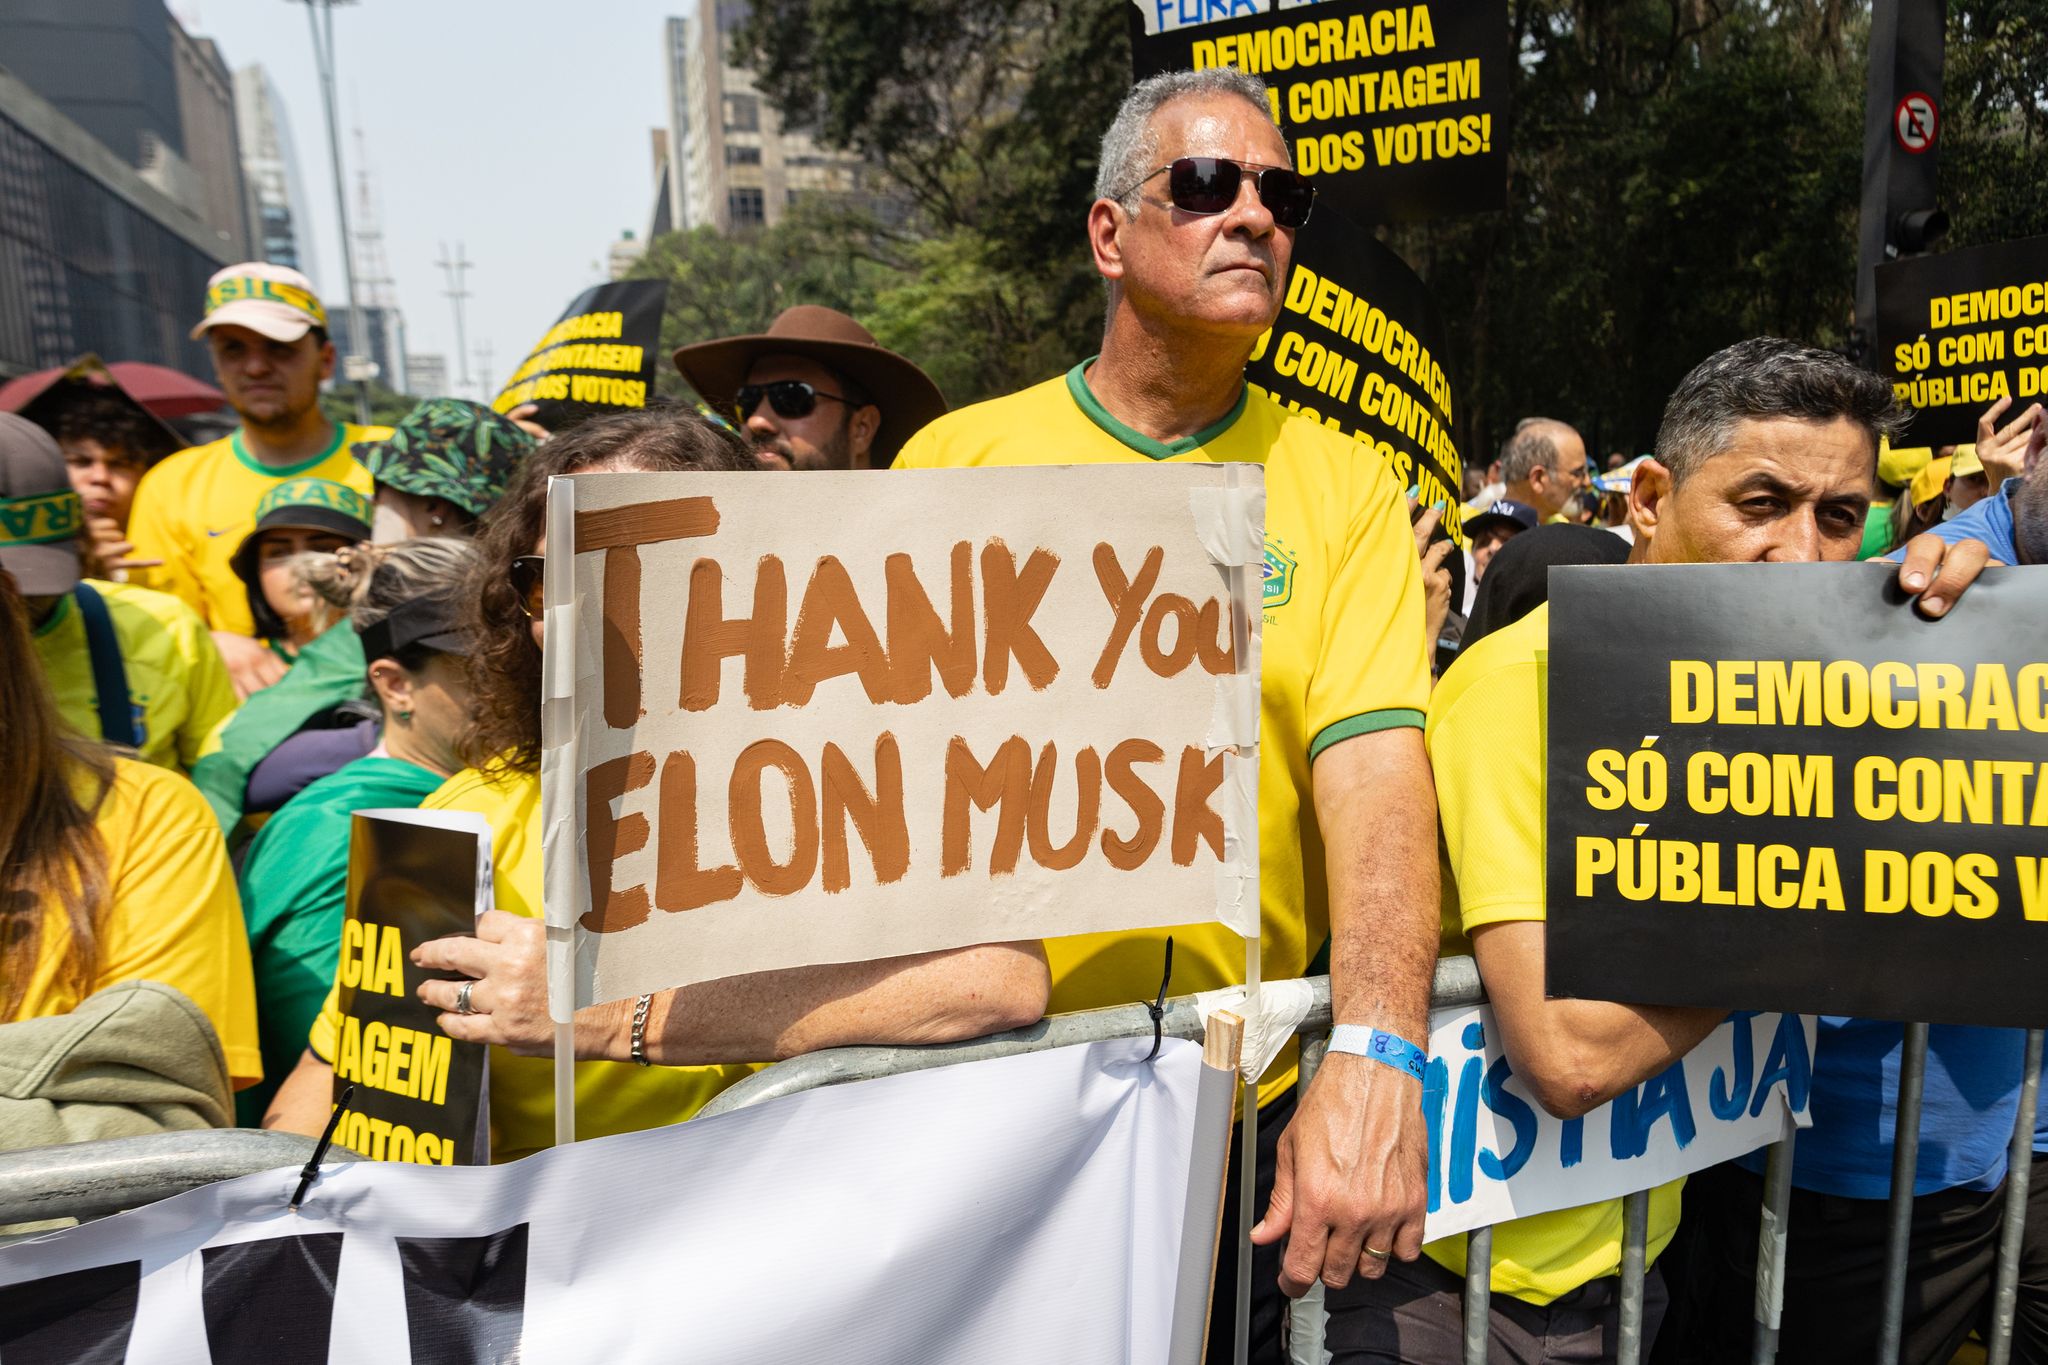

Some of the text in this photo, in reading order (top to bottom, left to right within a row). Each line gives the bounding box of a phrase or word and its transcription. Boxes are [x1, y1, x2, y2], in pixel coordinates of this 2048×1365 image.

[1192, 4, 1435, 75] DEMOCRACIA
[1288, 58, 1481, 124] CONTAGEM
[1296, 113, 1492, 177] DOS VOTOS!
[1930, 281, 2048, 330] DEMOC
[1274, 331, 1359, 404] COM
[1284, 264, 1453, 427] DEMOCRACIA
[1895, 333, 1931, 373] SÓ
[1938, 329, 2005, 368] COM
[571, 375, 646, 409] VOTOS!
[1893, 371, 2012, 410] PÚBLICA
[575, 495, 1061, 729] THANK
[1670, 660, 2048, 733] DEMOCRAC
[1586, 735, 1668, 812] SÓ
[1687, 750, 1834, 818] COM
[579, 729, 1232, 934] ELON MUSK
[1576, 823, 1846, 912] PÚBLICA
[1864, 849, 1999, 920] DOS
